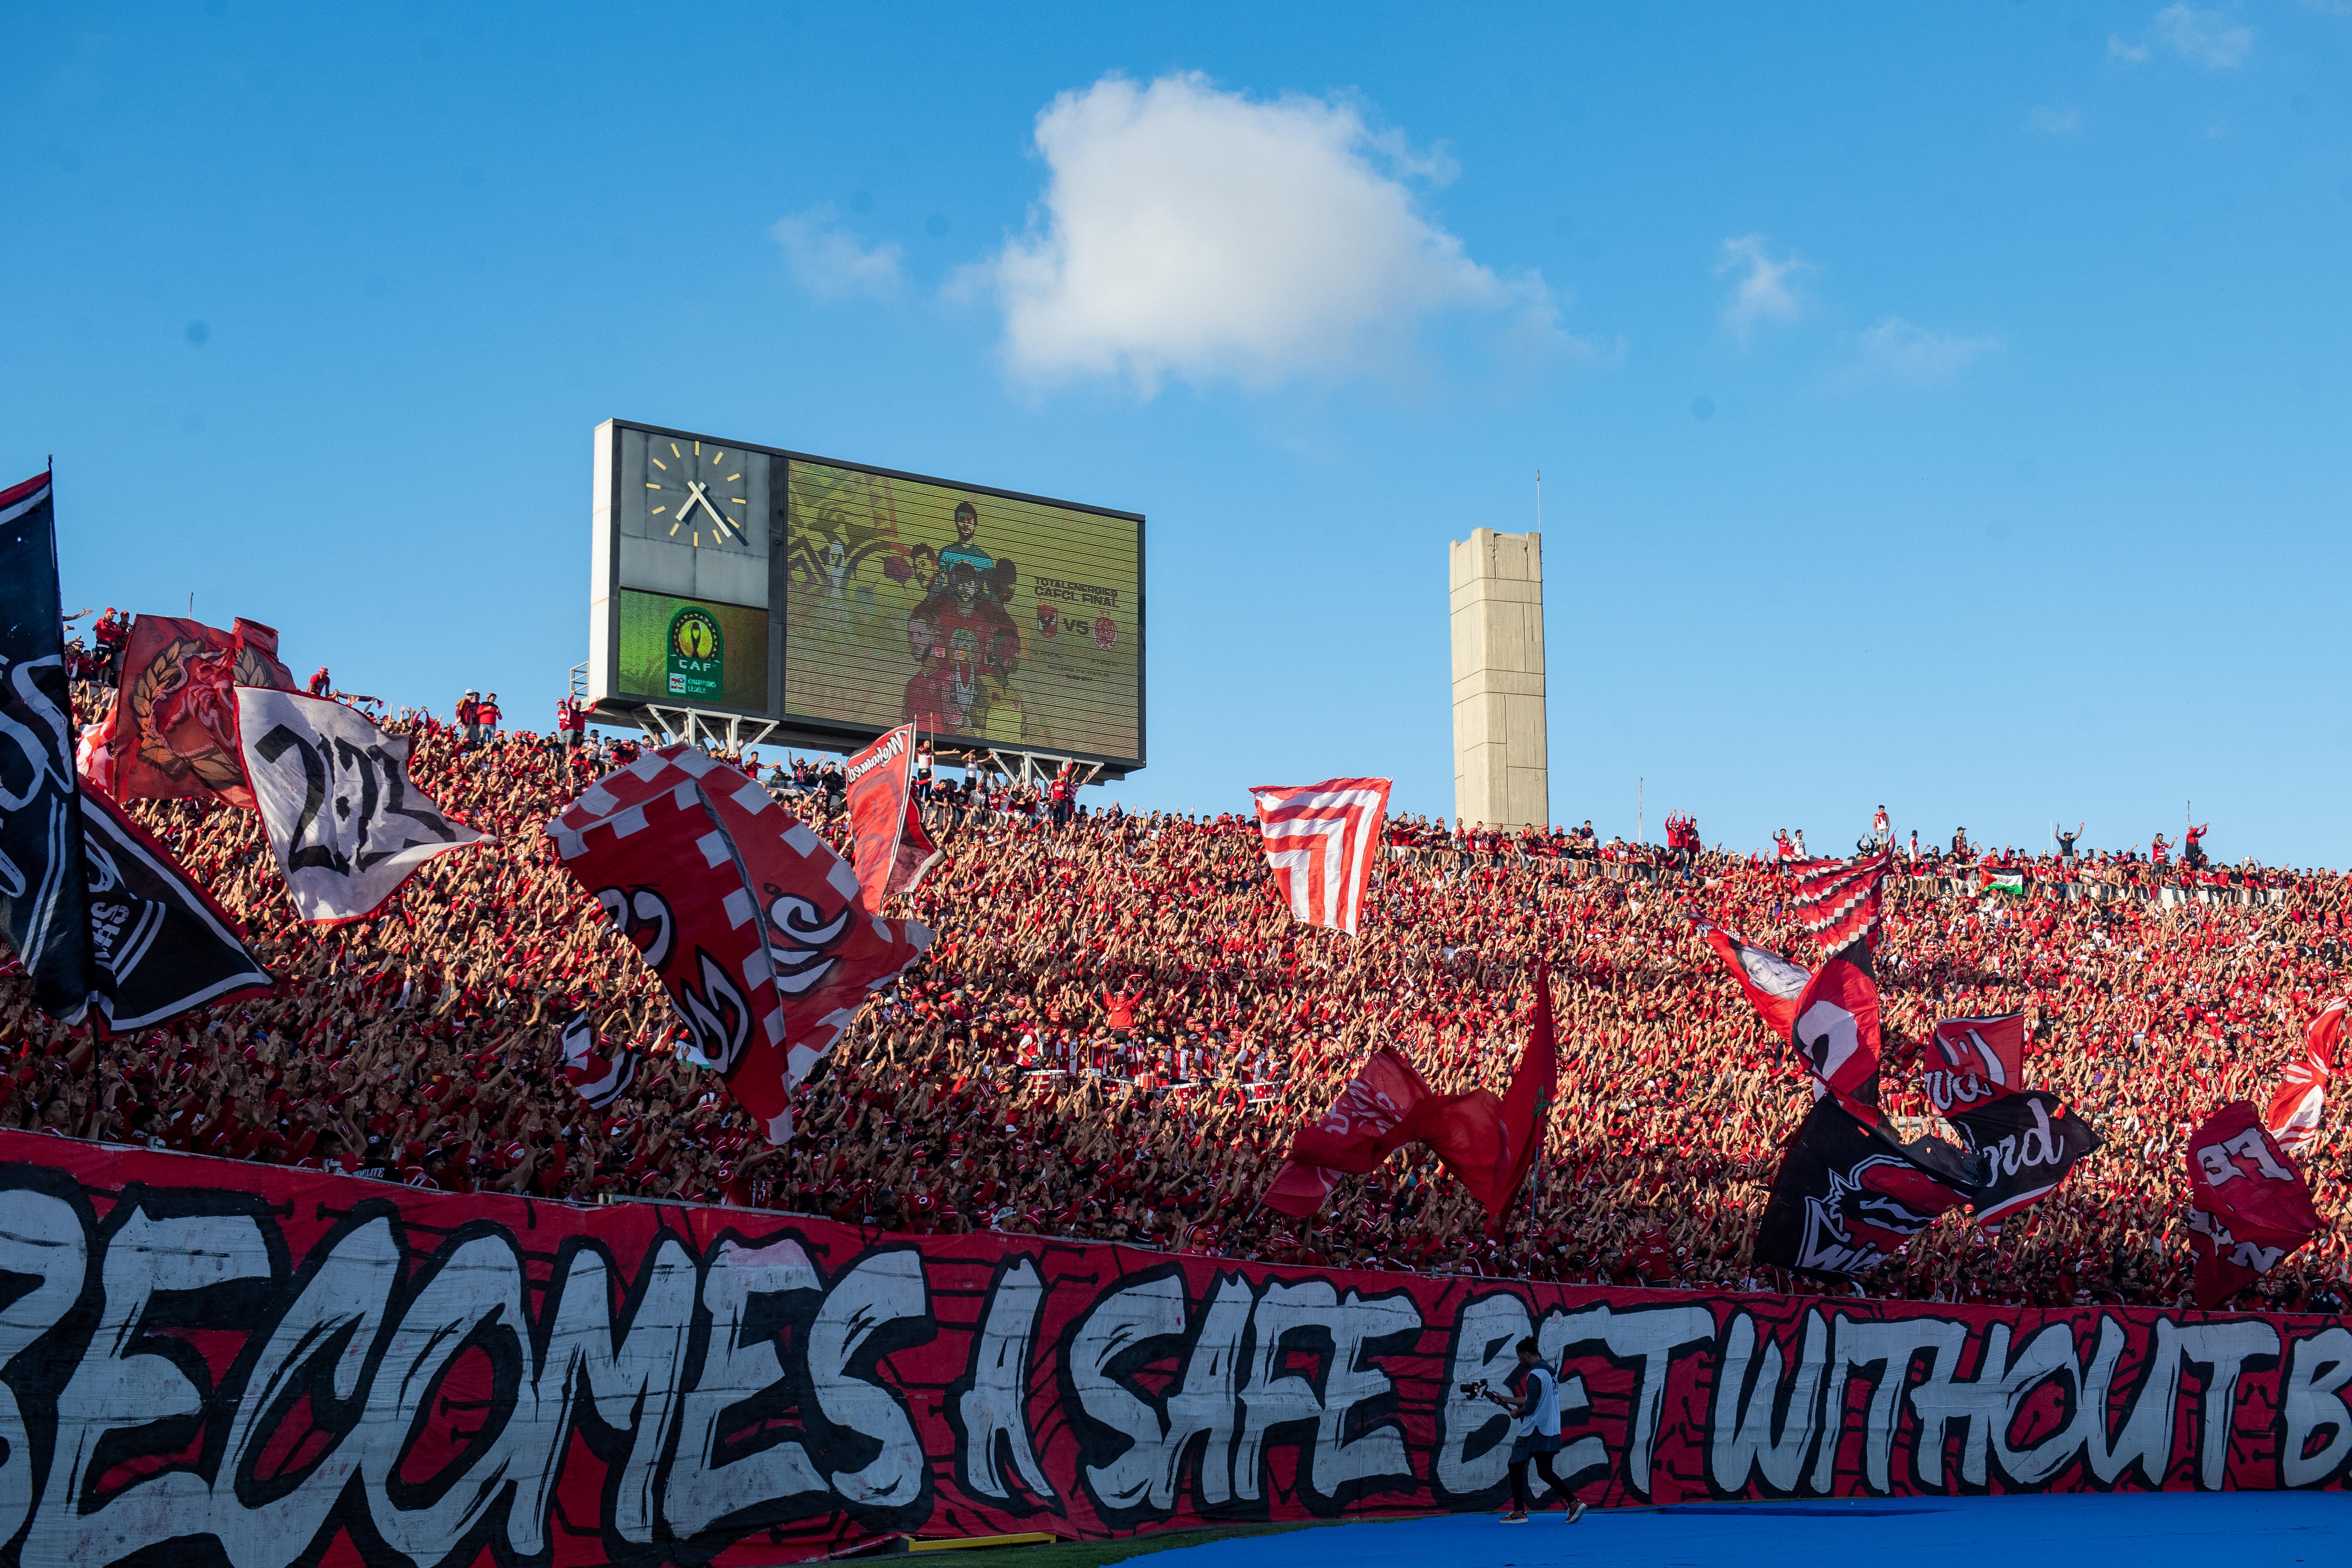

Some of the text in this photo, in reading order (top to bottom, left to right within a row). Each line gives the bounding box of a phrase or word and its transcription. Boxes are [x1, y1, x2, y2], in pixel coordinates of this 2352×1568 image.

[1035, 586, 1120, 608] CAFCL FINAL
[1064, 618, 1089, 635] VS
[678, 659, 711, 672] CAF
[961, 1258, 1055, 1499] A
[1069, 1270, 1422, 1510] SAFE
[1435, 1293, 1716, 1499] BET
[1711, 1308, 2280, 1494] WITHOUT
